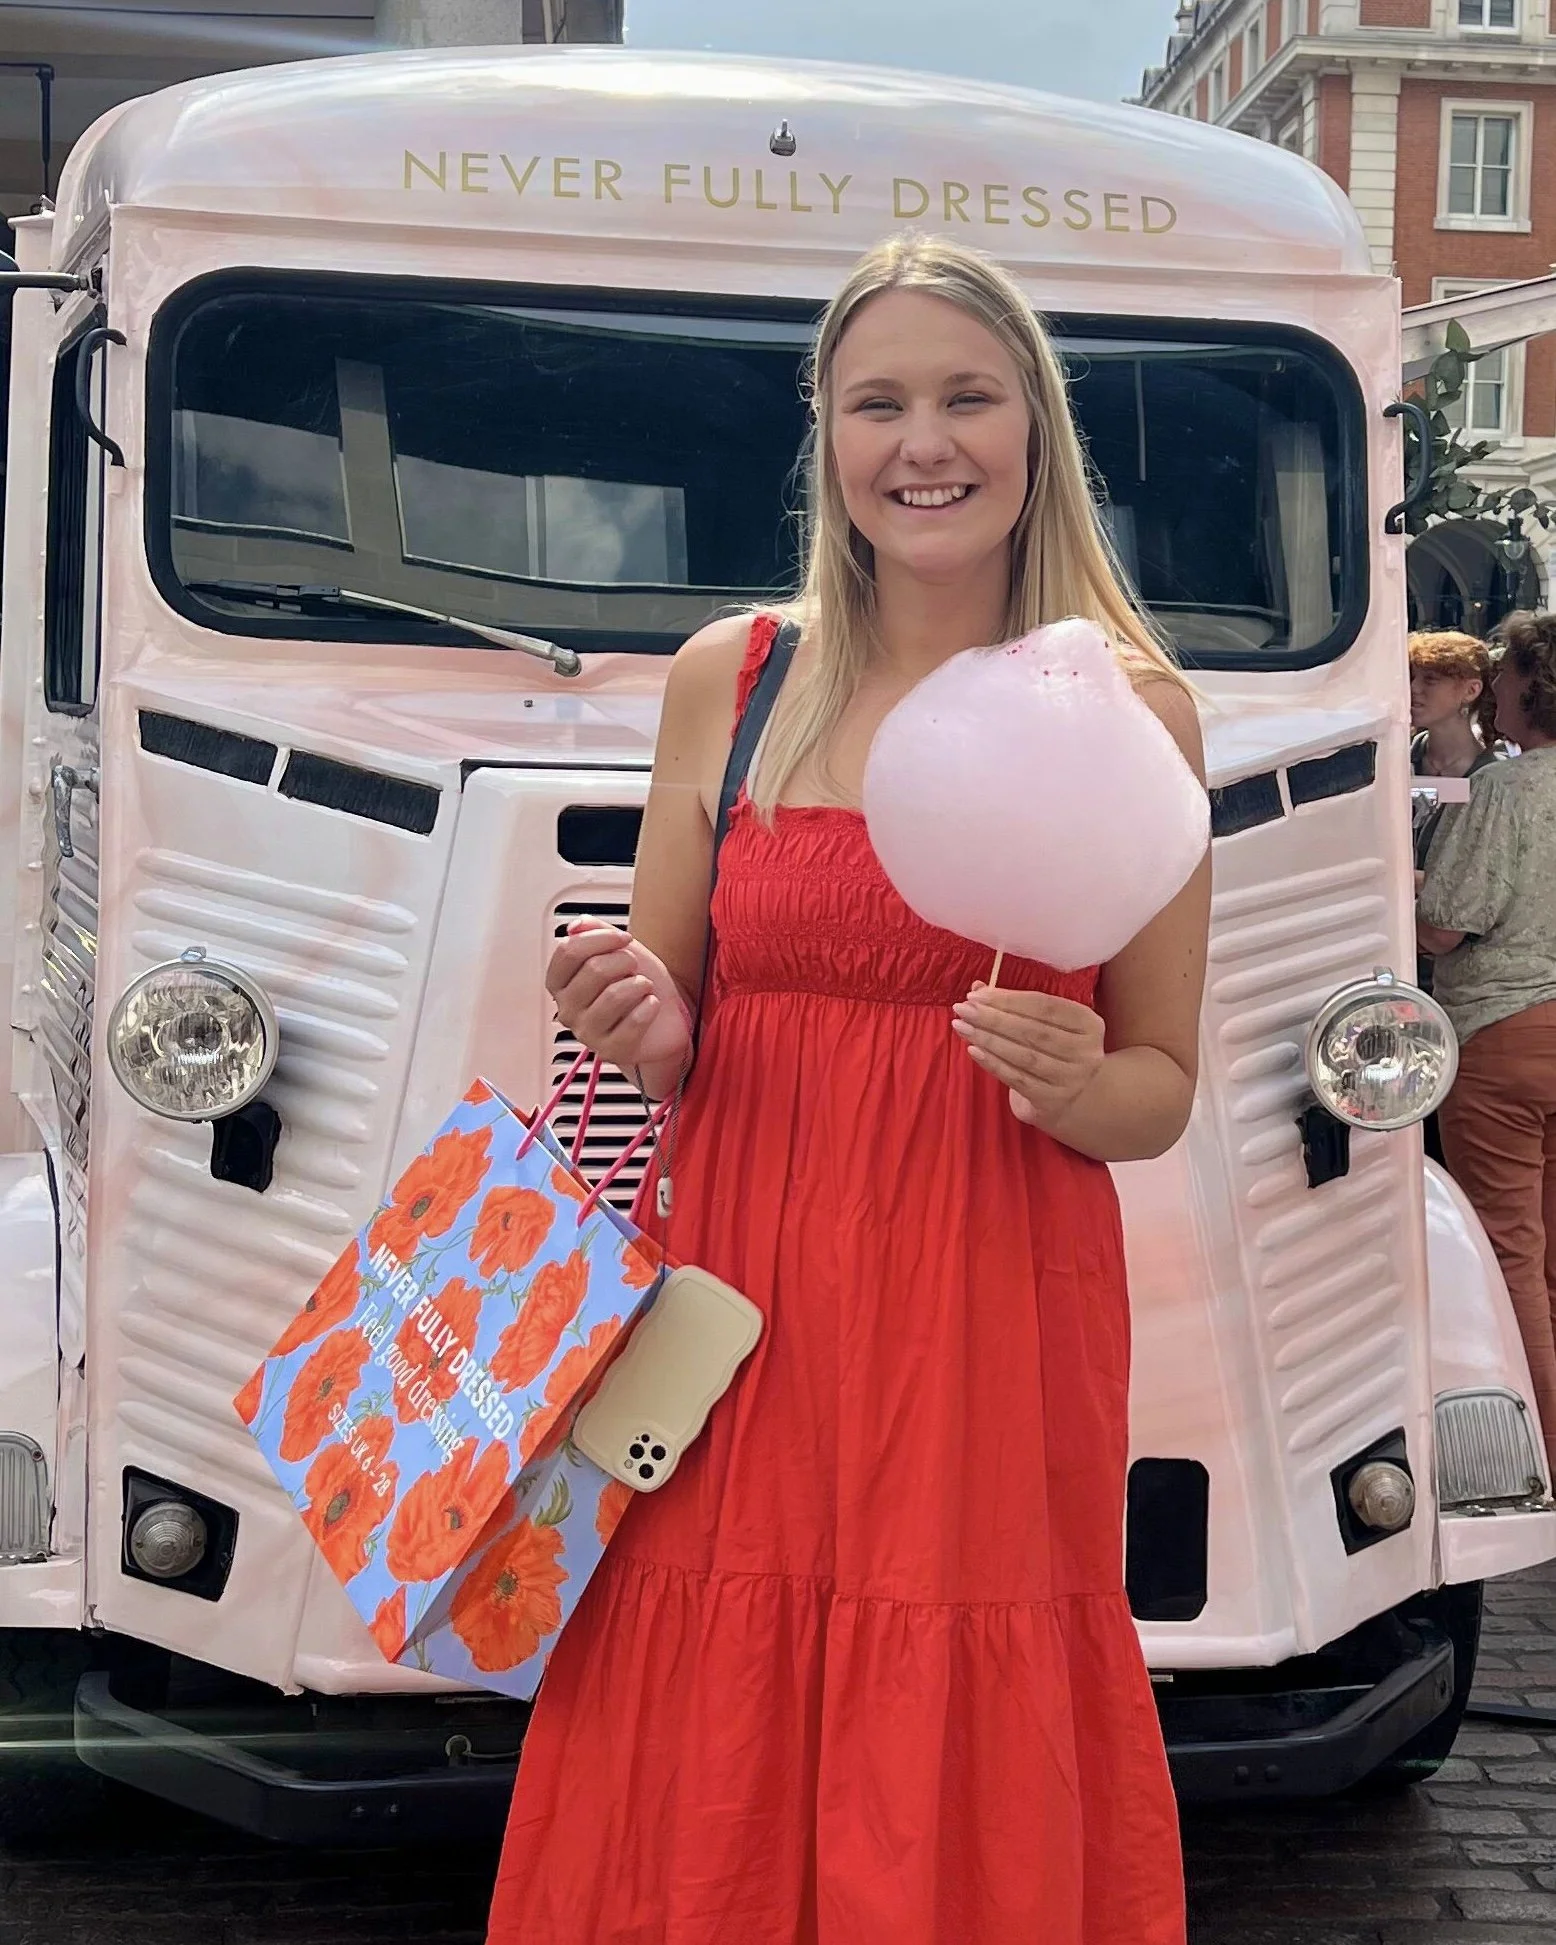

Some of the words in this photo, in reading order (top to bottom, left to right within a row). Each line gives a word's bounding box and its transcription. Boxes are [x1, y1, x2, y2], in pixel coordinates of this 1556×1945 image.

[403, 149, 624, 201] NEVER
[663, 163, 853, 215] FULLY
[893, 178, 1178, 236] DRESSED
[355, 1301, 395, 1352] Feel
[369, 1242, 420, 1311] NEVER
[409, 1295, 460, 1359] FULLY
[448, 1346, 515, 1440] DRESSED
[374, 1342, 423, 1389] good
[327, 1402, 357, 1445] SIZES
[350, 1435, 370, 1462] UK
[361, 1455, 375, 1471] 6
[372, 1472, 392, 1498] 28
[407, 1375, 465, 1465] dressing
